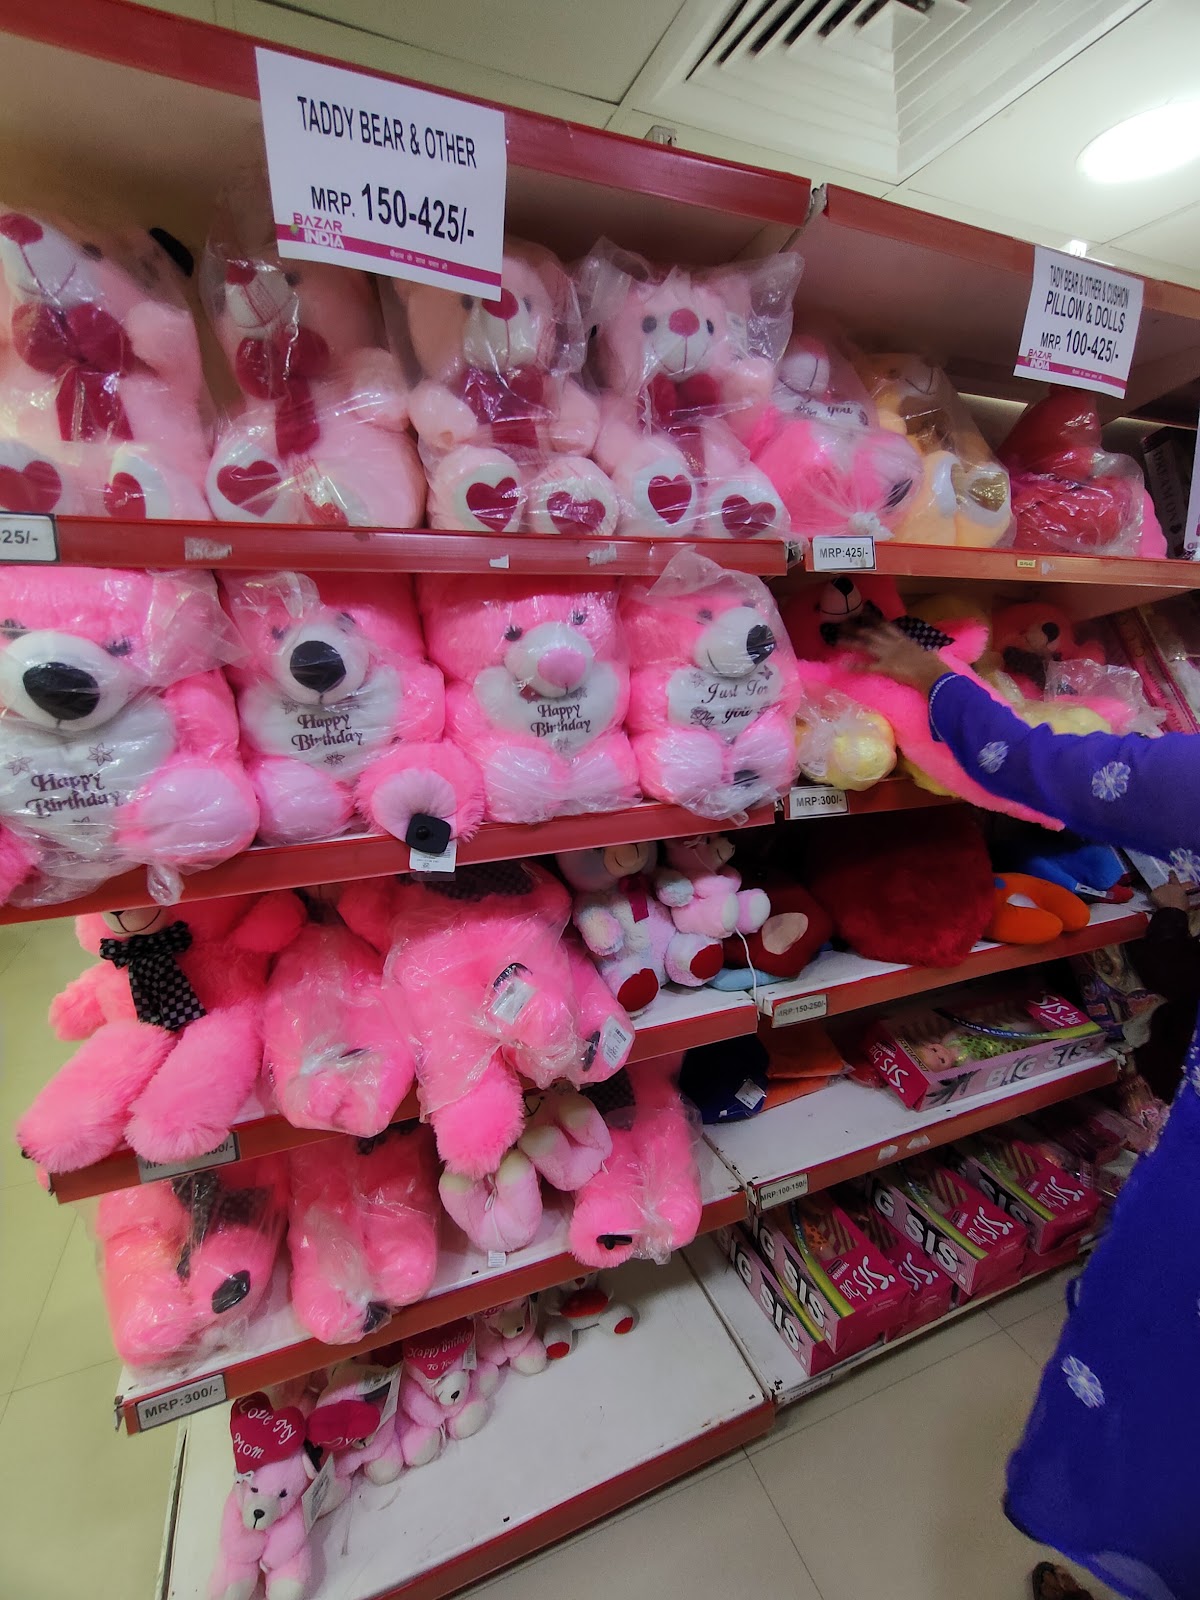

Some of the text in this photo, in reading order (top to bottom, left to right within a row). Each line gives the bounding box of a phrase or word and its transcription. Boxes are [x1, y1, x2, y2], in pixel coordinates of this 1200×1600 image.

[297, 96, 478, 169] TADDY BEAR & OTHER
[292, 212, 344, 234] BAZAR
[310, 183, 476, 245] MRP. 150-425/-
[303, 229, 345, 250] INDIA
[1063, 269, 1079, 294] BEAR
[1084, 275, 1102, 301] OTHER
[1107, 282, 1131, 309] CUSHION
[1044, 290, 1126, 334] PILLOW & DOLLS
[1028, 348, 1052, 361] BAZAR
[1066, 328, 1119, 364] 100-425/-
[1029, 358, 1050, 371] INDIA
[0, 529, 39, 545] 25/-
[819, 547, 869, 559] MRP:425/-
[700, 683, 738, 704] Just
[537, 704, 582, 719] Happy
[721, 707, 753, 725] you
[297, 713, 352, 732] Happy
[530, 719, 592, 738] Birthday
[290, 730, 363, 752] Birthday
[31, 772, 106, 792] Happy
[25, 790, 124, 818] Birthday
[796, 794, 842, 807] MRP:300/-
[984, 1053, 1038, 1087] BIG
[760, 1180, 807, 1201] MRP:100-150/-
[839, 1279, 868, 1301] BIG
[408, 1346, 440, 1359] Happy
[144, 1385, 219, 1419] MRP:300/-
